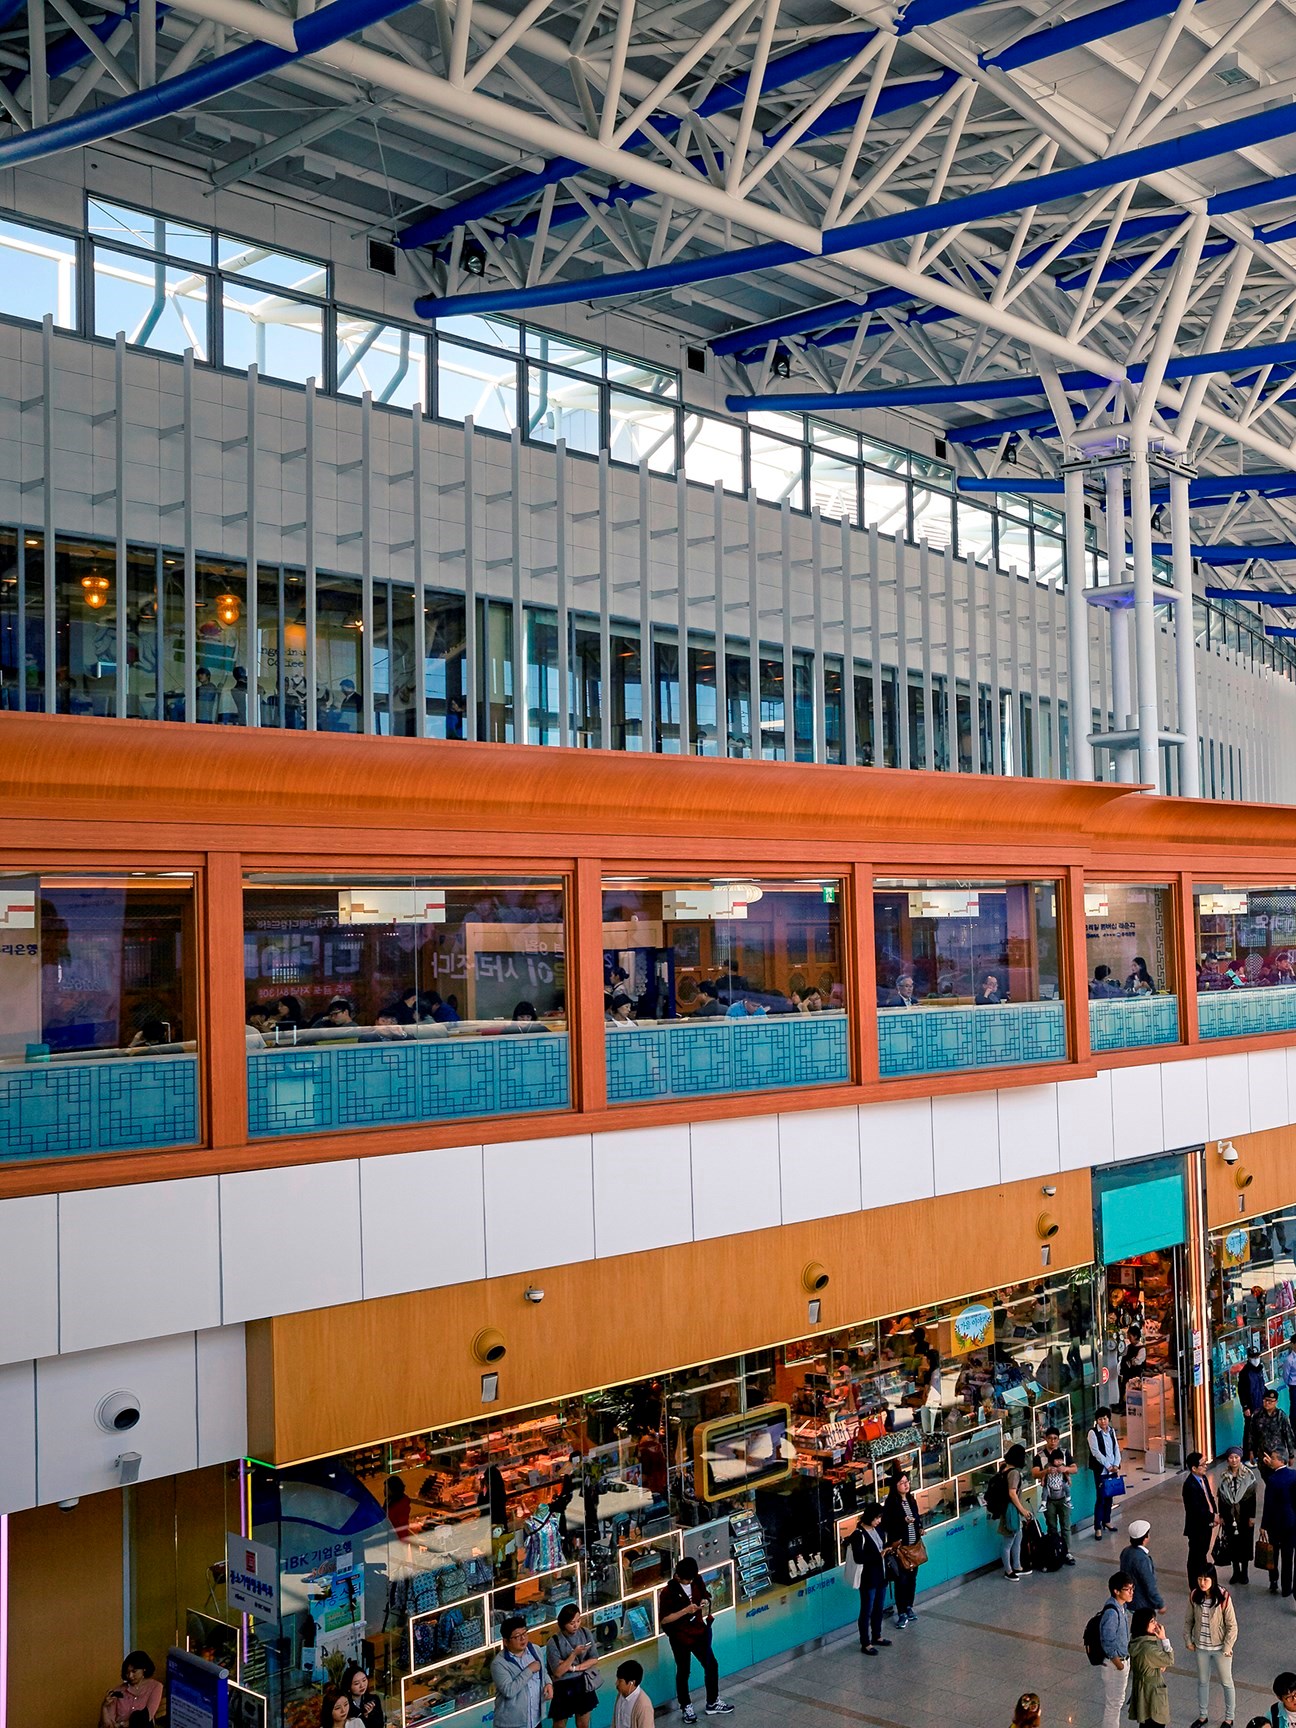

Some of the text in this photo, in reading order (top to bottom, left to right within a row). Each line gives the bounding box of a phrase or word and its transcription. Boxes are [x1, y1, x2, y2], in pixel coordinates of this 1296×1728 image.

[1, 944, 38, 956] 리은행
[285, 1540, 352, 1571] IBK 기업은행
